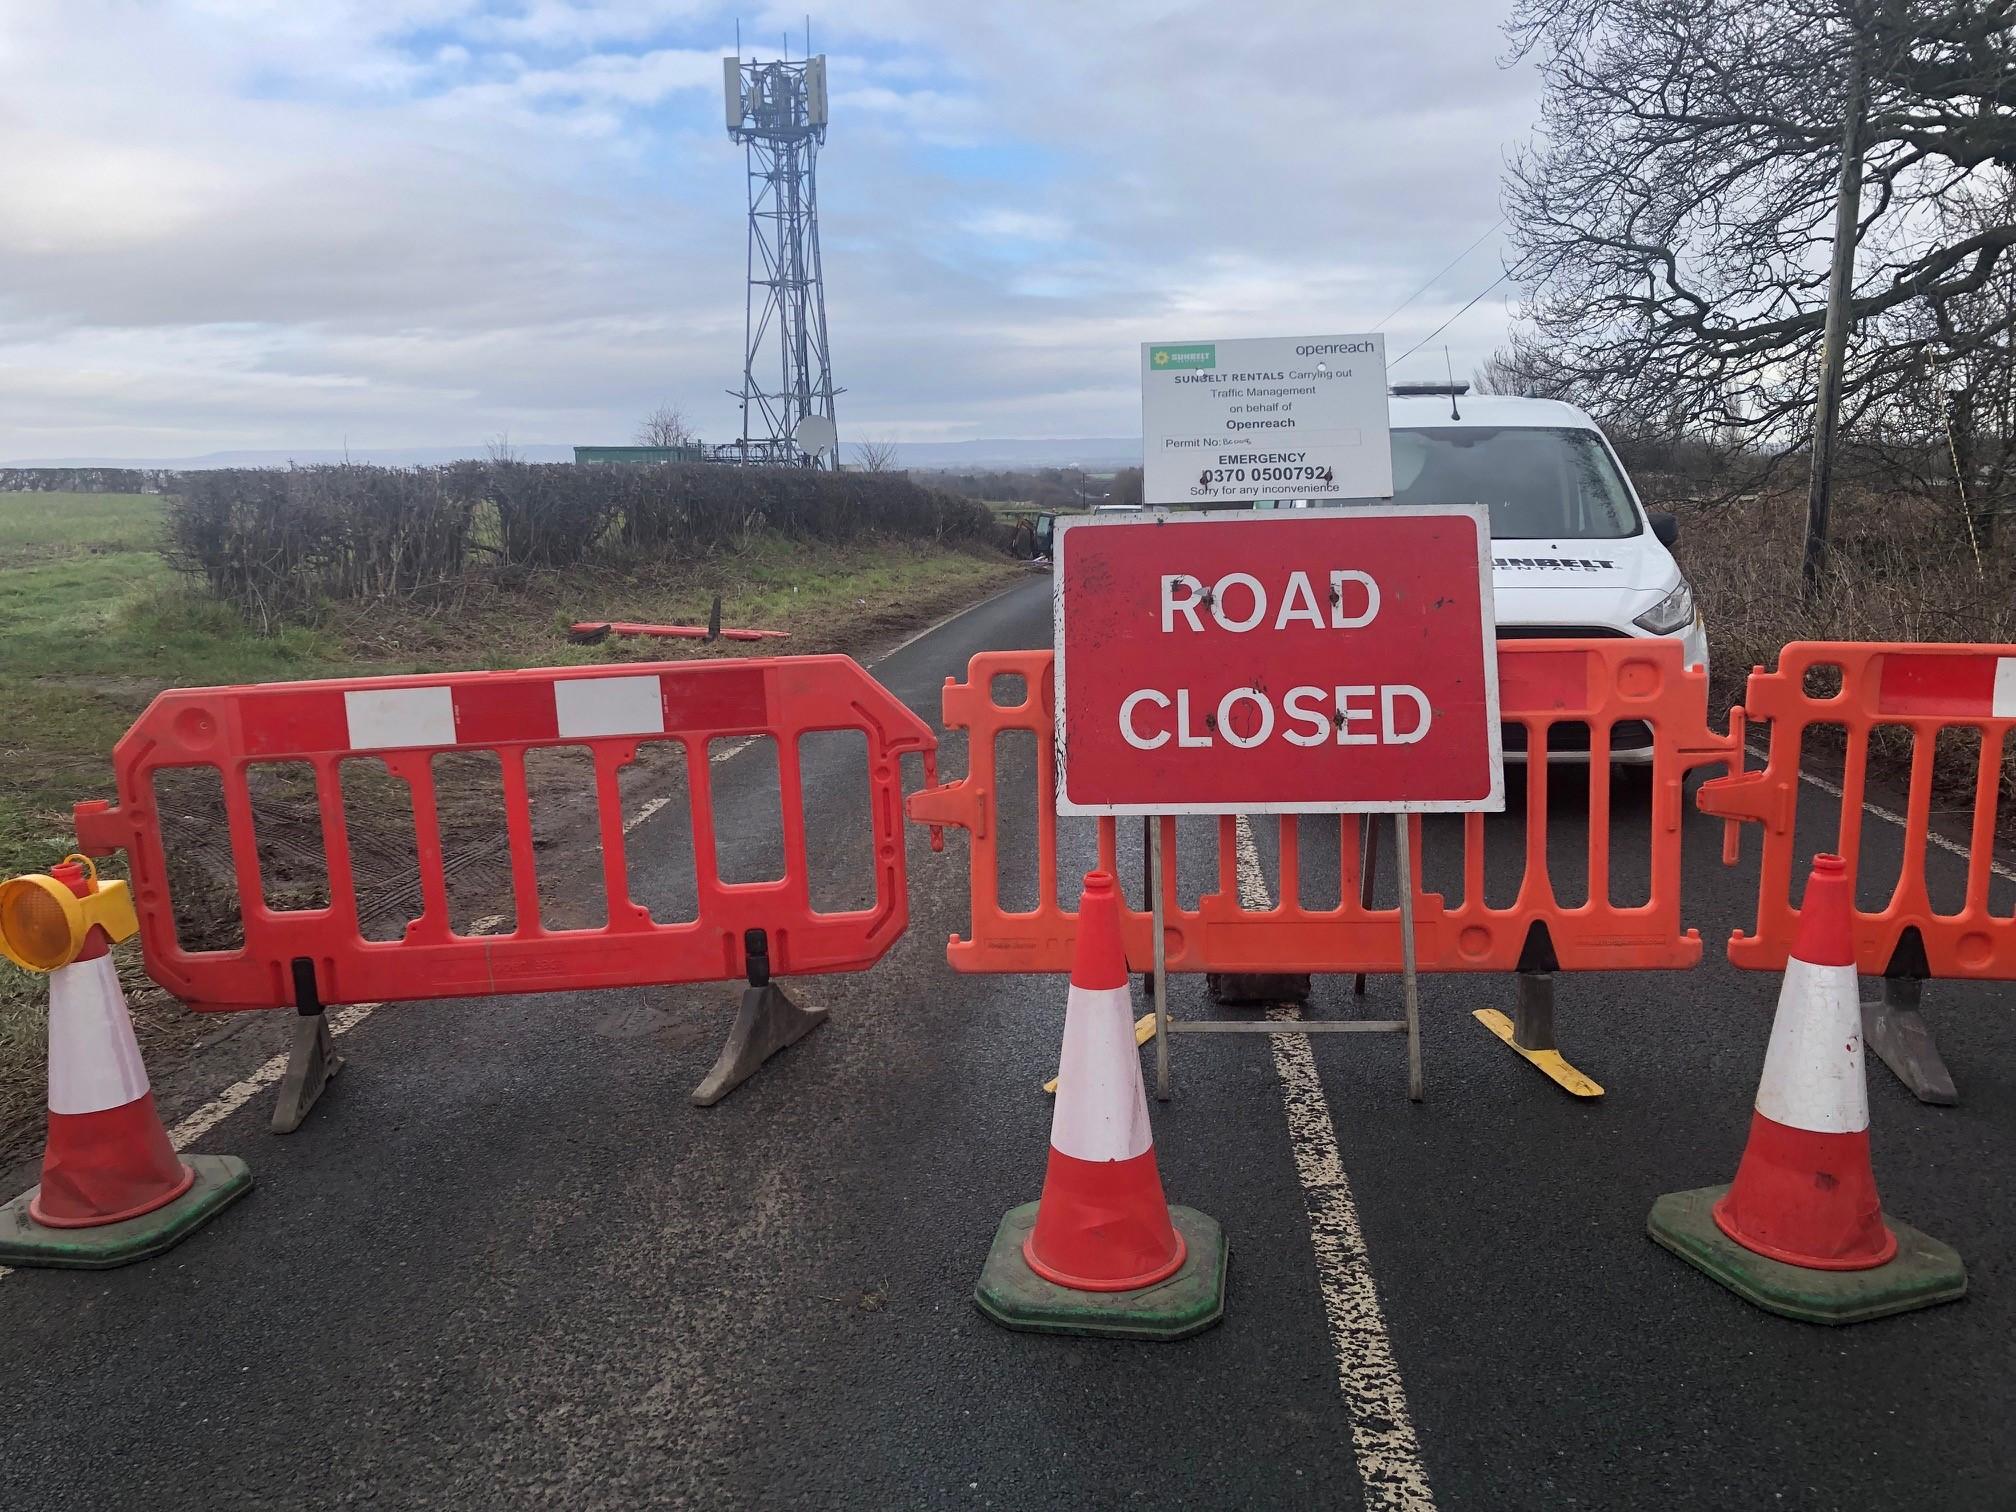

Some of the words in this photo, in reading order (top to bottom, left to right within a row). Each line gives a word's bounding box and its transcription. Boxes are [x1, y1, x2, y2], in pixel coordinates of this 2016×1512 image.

[1296, 341, 1374, 356] openreach
[1174, 374, 1228, 384] SUNBELT
[1232, 371, 1284, 382] RENTALS
[1289, 370, 1333, 381] Carrying
[1336, 369, 1353, 378] out
[1211, 388, 1244, 399] Traffic
[1247, 386, 1316, 399] Management
[1229, 405, 1243, 414] on
[1246, 403, 1279, 413] behalf
[1282, 402, 1292, 412] of
[1226, 418, 1296, 431] Openreach
[1165, 438, 1200, 448] Permit
[1203, 438, 1222, 447] No:
[1219, 452, 1306, 465] EMERGENCY
[1204, 468, 1246, 483] 0370
[1251, 465, 1326, 482] 0500792
[1190, 486, 1219, 497] Sorry
[1222, 485, 1237, 495] for
[1240, 486, 1259, 496] any
[1262, 483, 1340, 494] inconvenience
[1492, 558, 1614, 568] UNBELT
[1161, 570, 1381, 633] ROAD
[1118, 684, 1433, 750] CLOSED
